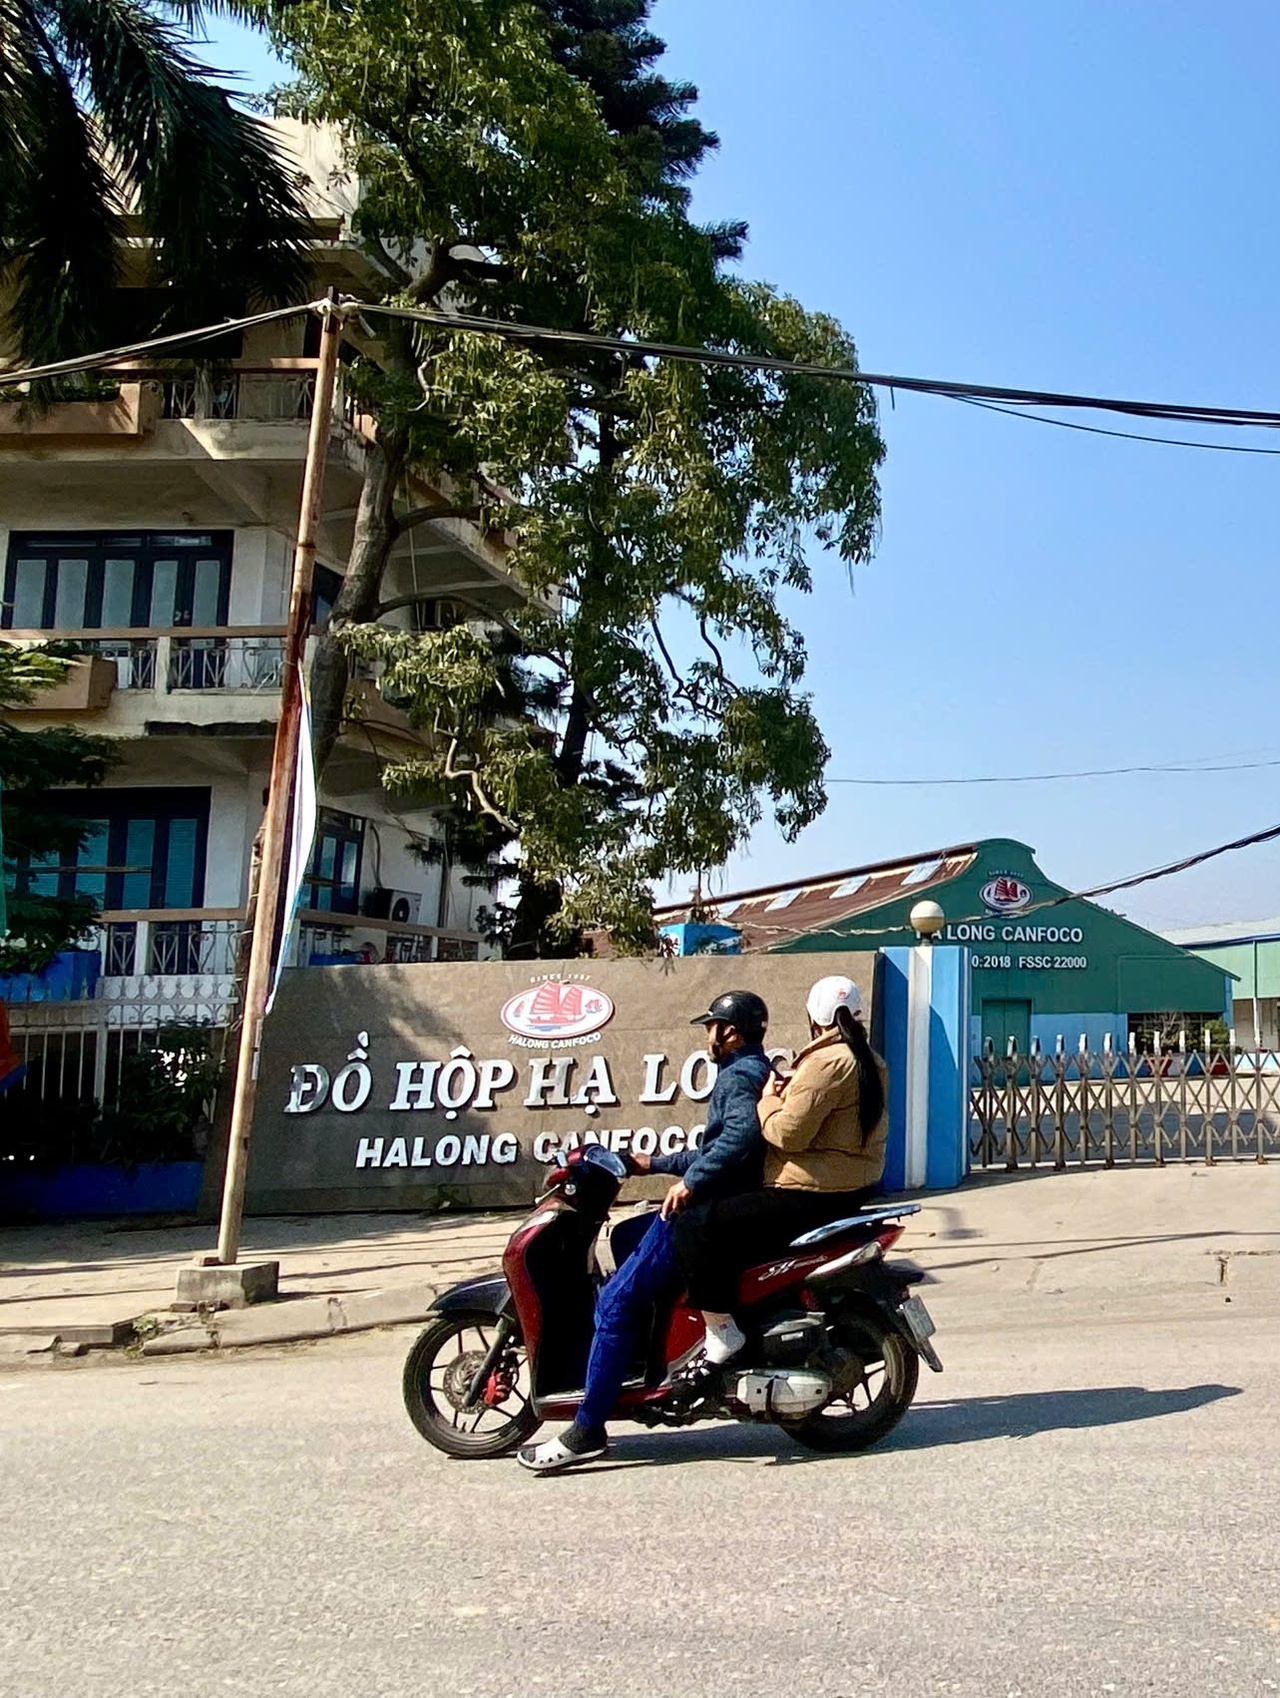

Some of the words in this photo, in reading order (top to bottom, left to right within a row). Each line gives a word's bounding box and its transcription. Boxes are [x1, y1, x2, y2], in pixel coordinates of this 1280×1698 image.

[947, 924, 995, 940] LONG
[1001, 925, 1083, 943] CANFOCO
[1018, 955, 1051, 969] FSSC
[1054, 956, 1087, 969] 22000
[508, 1034, 549, 1049] HALONG
[550, 1031, 602, 1049] CANFOCO
[283, 1030, 372, 1113] ĐỒ
[389, 1045, 515, 1121] HỘP
[523, 1054, 617, 1115] HẠ
[355, 1132, 518, 1168] HALONG
